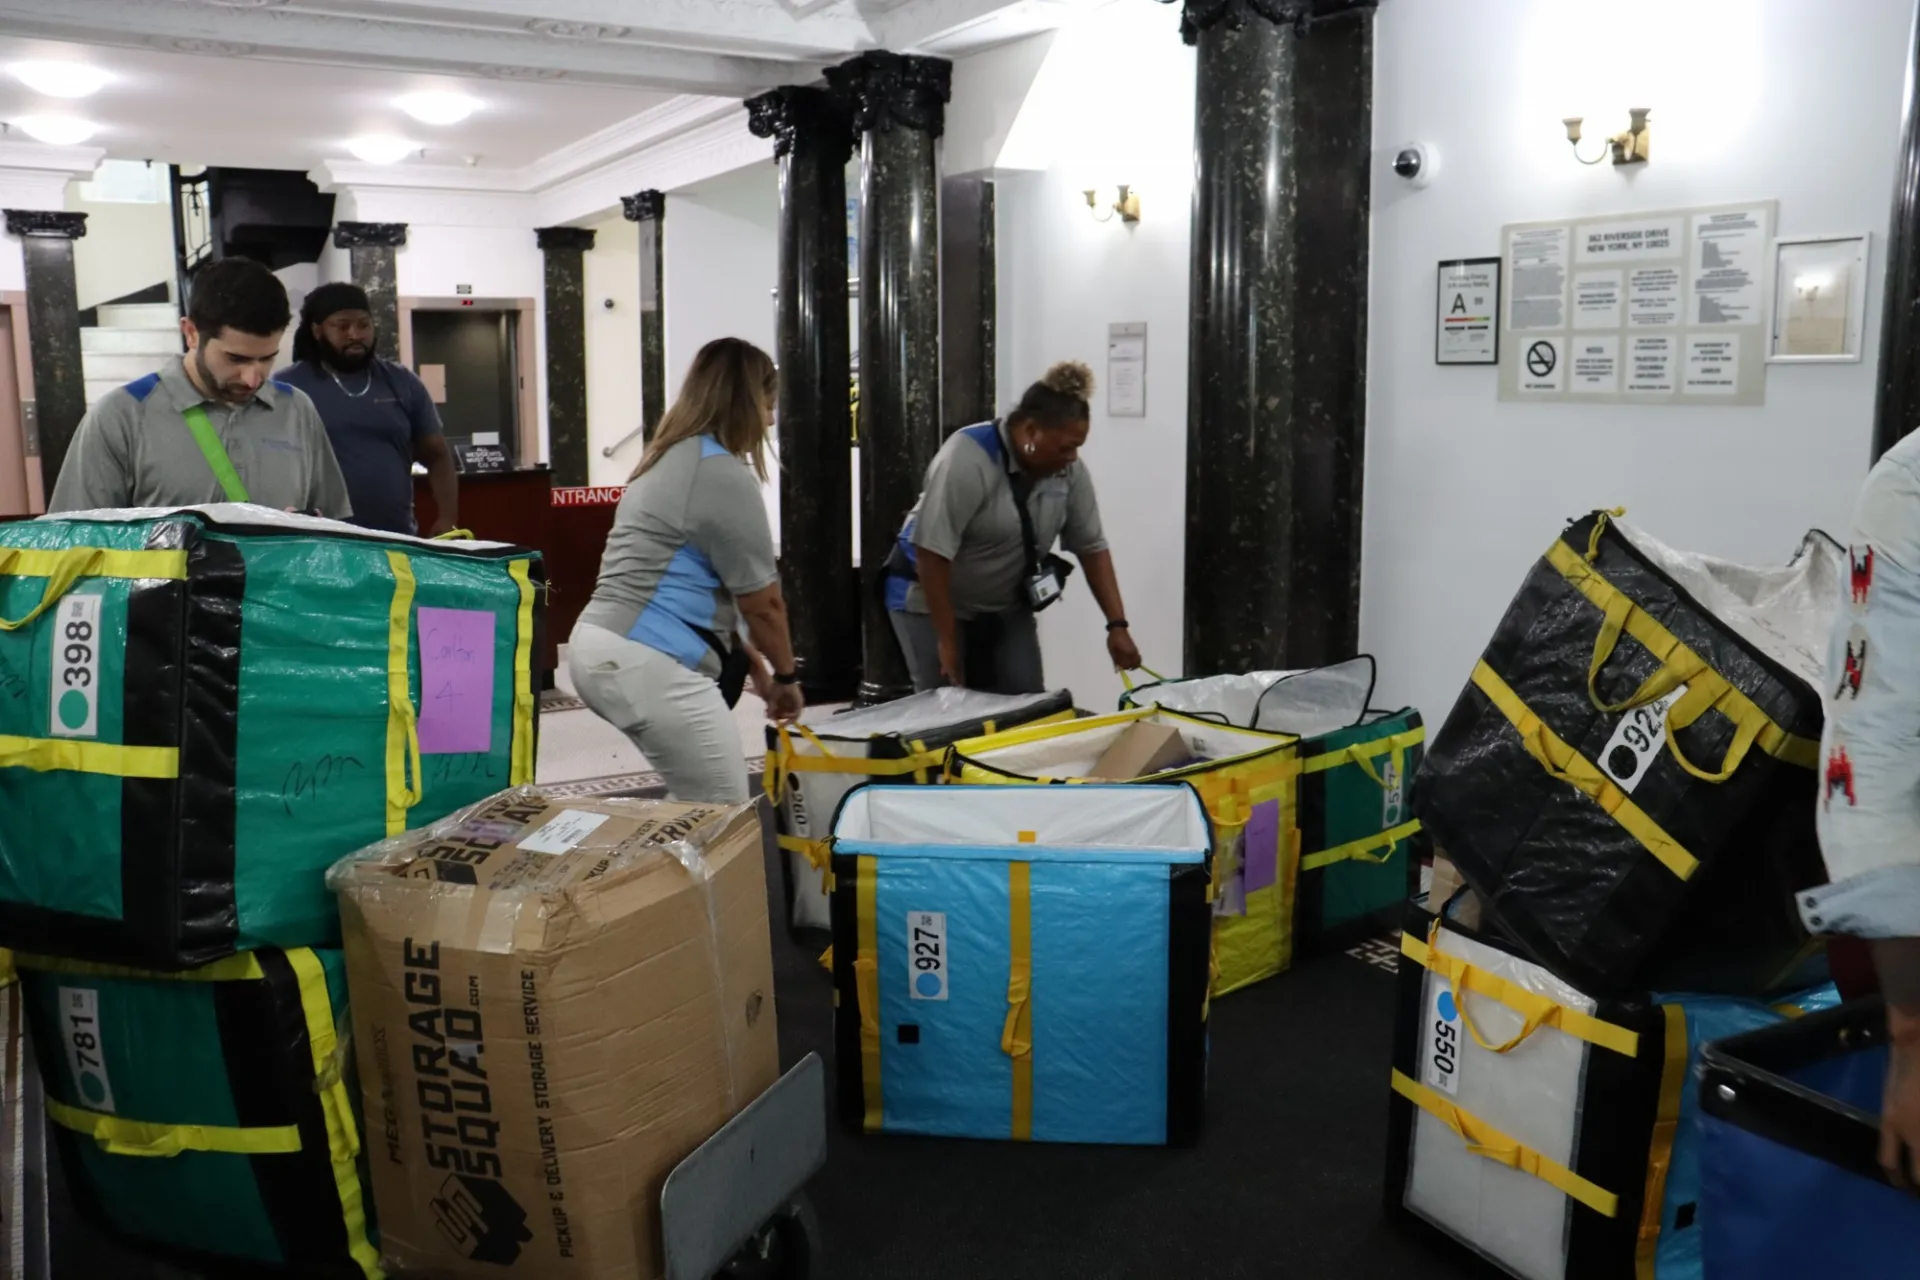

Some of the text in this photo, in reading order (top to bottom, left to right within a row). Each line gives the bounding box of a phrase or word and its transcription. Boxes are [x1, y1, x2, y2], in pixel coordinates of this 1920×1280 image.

[1644, 228, 1669, 239] DRIVE
[1451, 293, 1466, 314] A
[552, 488, 628, 505] NTRANC
[63, 620, 92, 687] 398
[1388, 773, 1400, 804] 57
[914, 927, 941, 970] 927
[521, 970, 540, 1035] SERVICE
[70, 1014, 100, 1068] 781
[404, 937, 463, 1172] STORAGE
[1434, 1020, 1456, 1074] 550
[444, 1008, 504, 1178] SQUAD
[528, 1041, 550, 1109] STORAGE
[537, 1115, 561, 1186] DELIVERY
[552, 1206, 574, 1258] PICKUP
